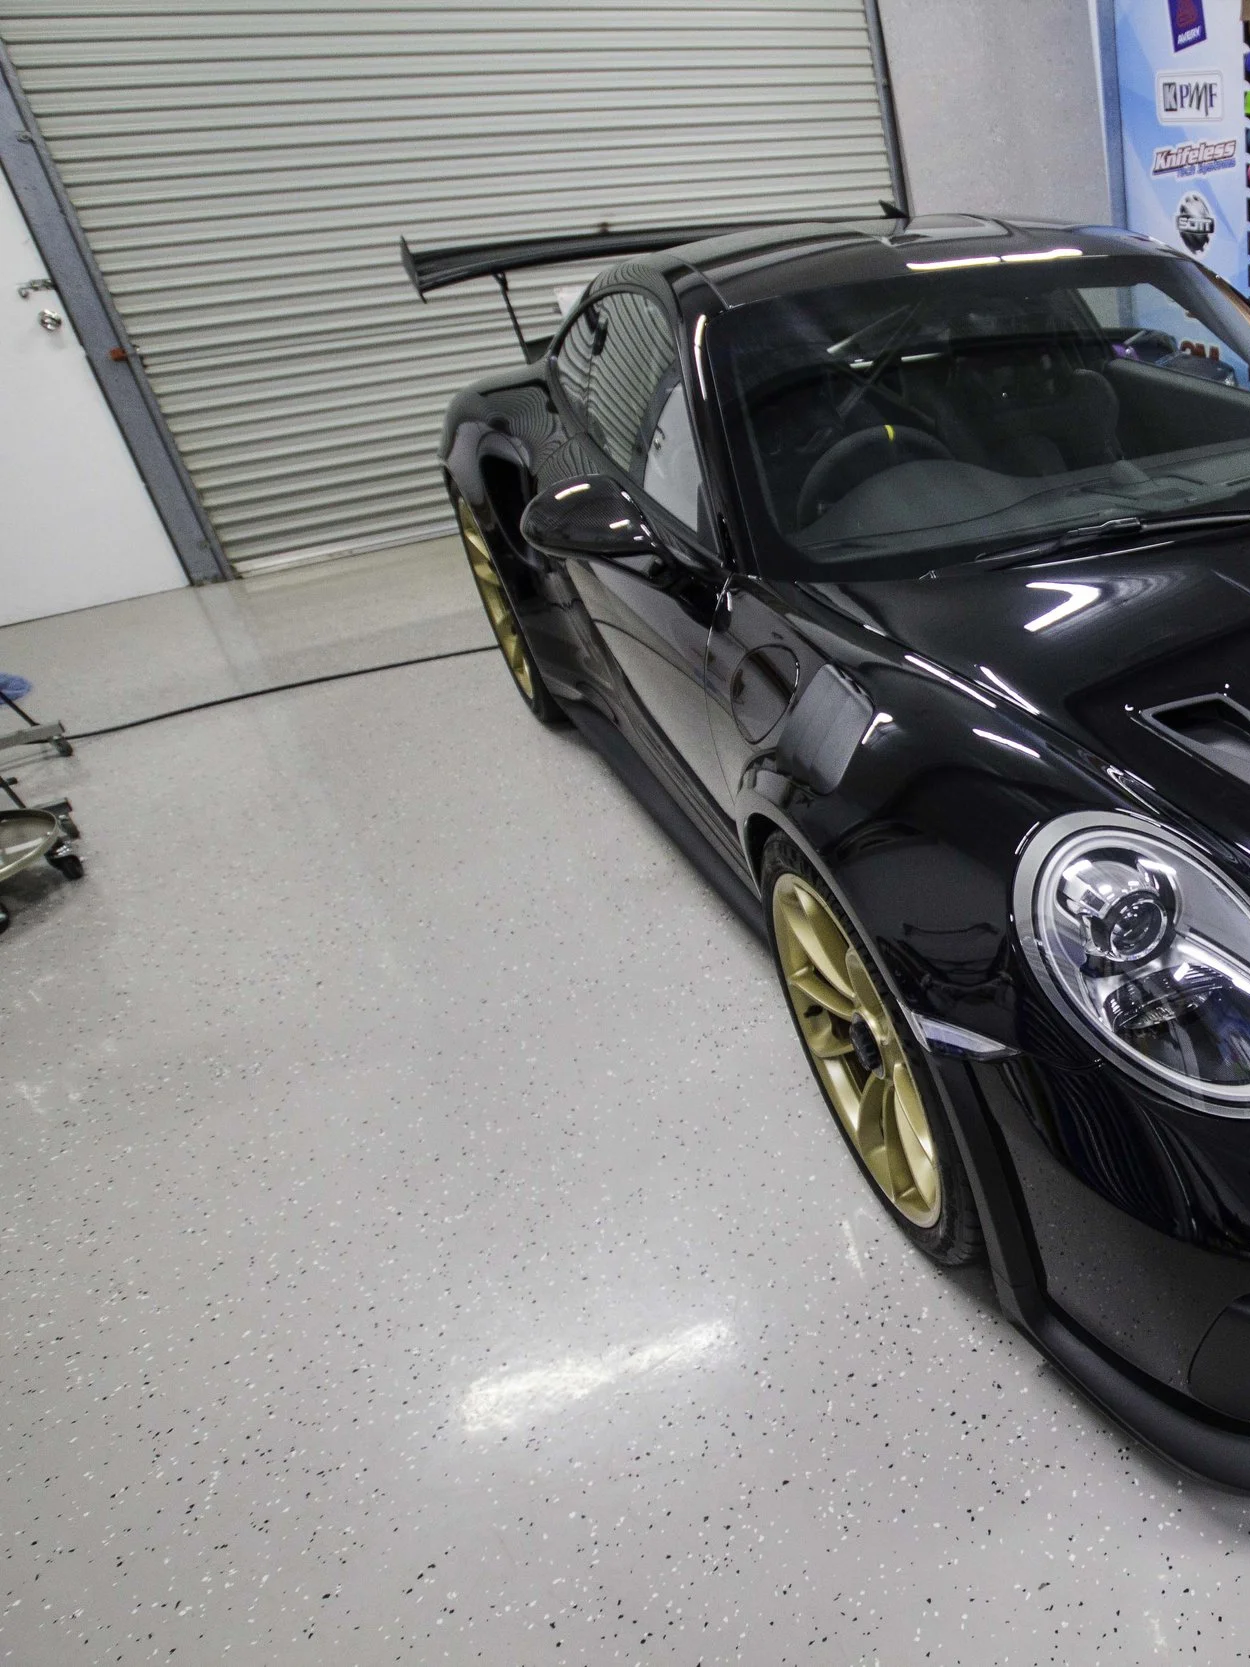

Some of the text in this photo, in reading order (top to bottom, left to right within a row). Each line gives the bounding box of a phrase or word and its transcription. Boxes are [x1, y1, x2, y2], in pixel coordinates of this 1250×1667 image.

[1177, 25, 1202, 45] AVERY
[1162, 81, 1218, 117] KPMF
[1153, 140, 1236, 172] Knifeless
